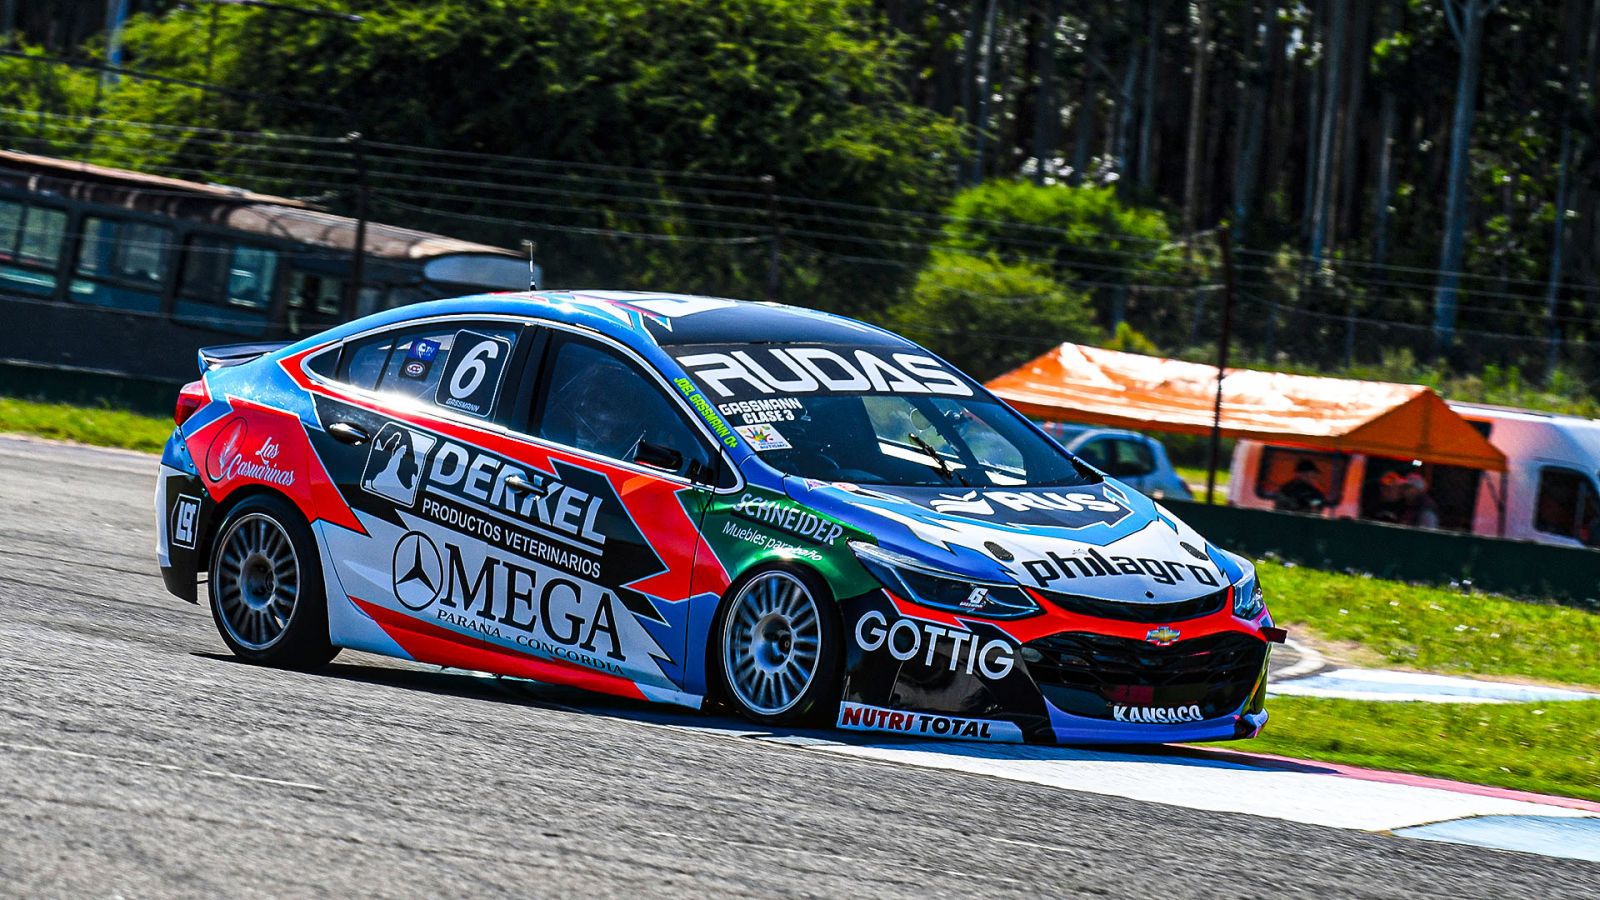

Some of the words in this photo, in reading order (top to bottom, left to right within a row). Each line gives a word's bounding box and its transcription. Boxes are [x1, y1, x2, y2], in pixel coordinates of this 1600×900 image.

[450, 341, 499, 399] 6
[676, 348, 974, 397] RUDAS
[446, 398, 480, 412] GASSMANN
[674, 377, 695, 396] JOEL
[689, 393, 730, 438] GASSMANN
[718, 397, 803, 416] GASSMANN
[742, 411, 784, 424] CLASE
[783, 409, 795, 421] 3
[255, 436, 279, 465] Las
[219, 453, 296, 487] Casuarinas
[985, 490, 1120, 512] RUS
[722, 521, 767, 546] Muebles
[732, 493, 843, 545] SCHNEIDER
[422, 498, 501, 542] PRODUCTOS
[504, 529, 601, 579] VETERINARIOS
[1022, 547, 1220, 588] philagro
[440, 542, 626, 662] MEGA
[968, 587, 988, 604] 6
[436, 608, 502, 639] PARANA
[515, 634, 625, 676] CONCORDIA
[855, 610, 1015, 680] GOTTIG
[841, 707, 915, 732] NUTRI
[918, 716, 992, 739] TOTAL
[1113, 705, 1204, 723] KANSACO
